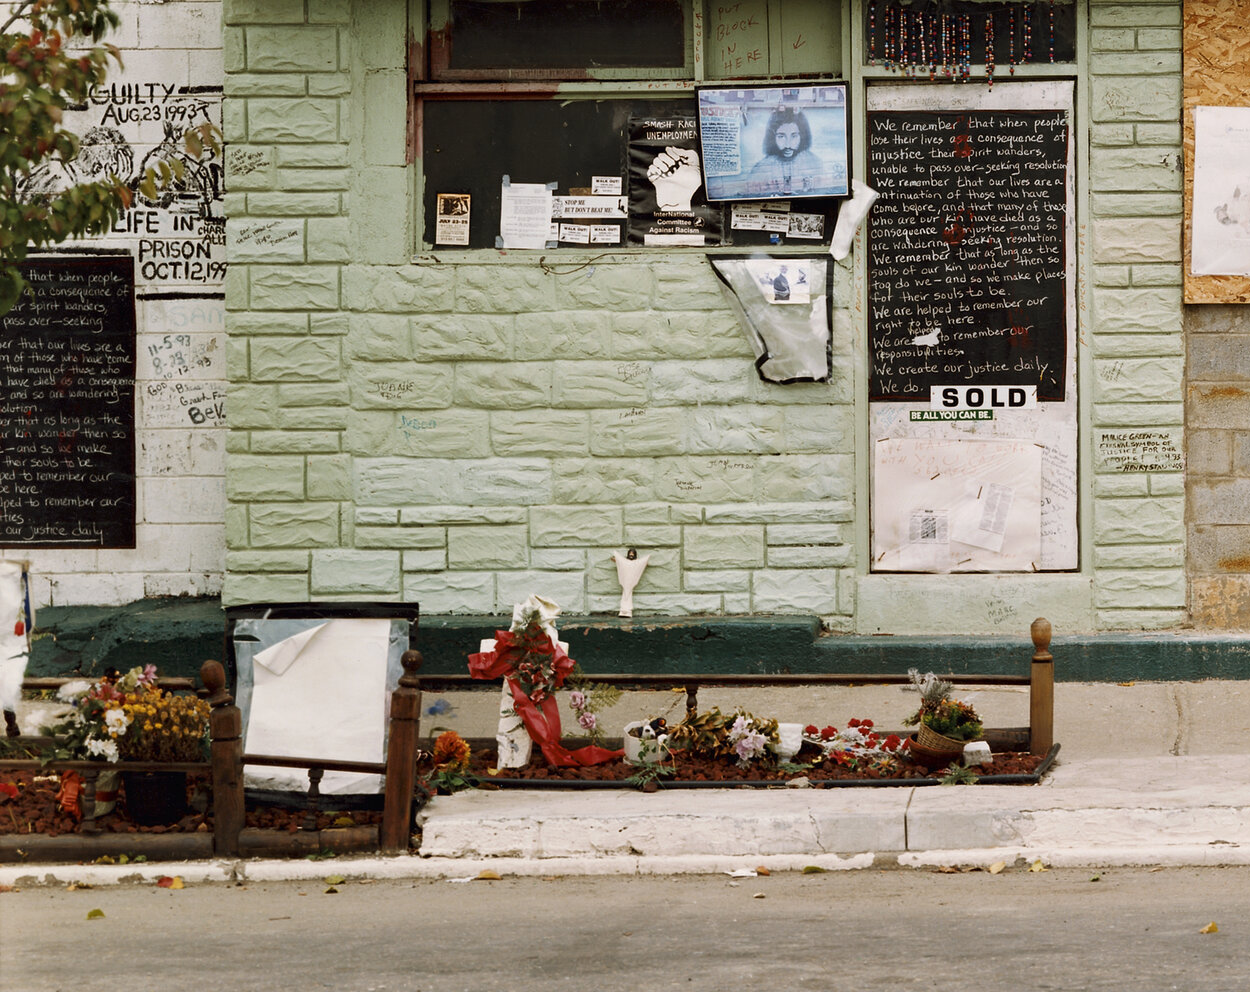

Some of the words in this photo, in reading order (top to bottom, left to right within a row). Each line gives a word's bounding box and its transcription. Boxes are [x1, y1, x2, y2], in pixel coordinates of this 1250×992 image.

[718, 3, 741, 20] PUT
[716, 15, 759, 42] BLOCK
[722, 43, 737, 62] IN
[724, 49, 762, 73] HERE
[88, 82, 176, 106] GUILTY
[643, 119, 674, 128] SMASH
[874, 118, 897, 131] We
[902, 117, 958, 132] remember
[968, 116, 995, 129] that
[1000, 117, 1028, 128] when
[1034, 113, 1066, 133] people
[871, 133, 890, 146] lose
[893, 133, 918, 145] their
[921, 133, 944, 145] lives
[949, 135, 966, 145] as
[966, 135, 974, 143] a
[977, 134, 1044, 148] consequence
[1053, 129, 1066, 142] of
[871, 147, 925, 164] injustice
[928, 147, 958, 158] their
[961, 147, 992, 162] spirit
[996, 144, 1046, 158] wanders,
[872, 163, 908, 175] unable
[913, 163, 925, 173] to
[929, 164, 951, 177] pass
[1024, 159, 1067, 170] resolution
[876, 177, 895, 187] We
[898, 177, 950, 187] remember
[957, 175, 984, 187] that
[1010, 175, 1030, 187] lives
[946, 189, 961, 199] of
[966, 188, 996, 200] those
[999, 188, 1020, 198] who
[1022, 188, 1050, 198] have
[873, 204, 898, 214] come
[902, 202, 940, 216] before,
[941, 202, 965, 212] and
[968, 202, 994, 212] that
[997, 203, 1025, 216] many
[1026, 199, 1039, 212] of
[111, 211, 160, 234] LIFE
[173, 215, 194, 232] IN
[649, 226, 674, 234] Against
[675, 226, 700, 234] Racism
[871, 225, 938, 243] consequence
[962, 223, 1006, 238] injustice
[1046, 223, 1058, 231] so
[871, 242, 889, 251] are
[1006, 232, 1062, 243] resolution.
[139, 239, 212, 263] PRISON
[873, 253, 891, 265] We
[895, 250, 951, 263] remember
[956, 247, 982, 261] that
[984, 250, 995, 258] as
[1000, 247, 1020, 261] long
[1037, 244, 1060, 255] the
[29, 268, 54, 283] that
[59, 269, 85, 283] when
[87, 269, 123, 289] people
[49, 287, 112, 304] consequence
[117, 285, 129, 297] of
[873, 305, 891, 319] We
[894, 307, 912, 316] are
[916, 302, 952, 318] helped
[973, 297, 1023, 311] remember
[1026, 296, 1049, 307] our
[875, 319, 903, 335] right
[874, 362, 893, 376] We
[898, 361, 939, 375] create
[943, 364, 965, 373] our
[964, 359, 1010, 380] justice
[880, 379, 899, 394] We
[903, 378, 924, 392] do.
[942, 387, 1027, 407] SOLD
[910, 411, 922, 420] BE
[922, 411, 939, 420] ALL
[939, 411, 957, 419] YOU
[958, 410, 976, 419] CAN
[978, 410, 992, 419] BE.
[36, 471, 87, 482] remember
[23, 522, 68, 541] justice
